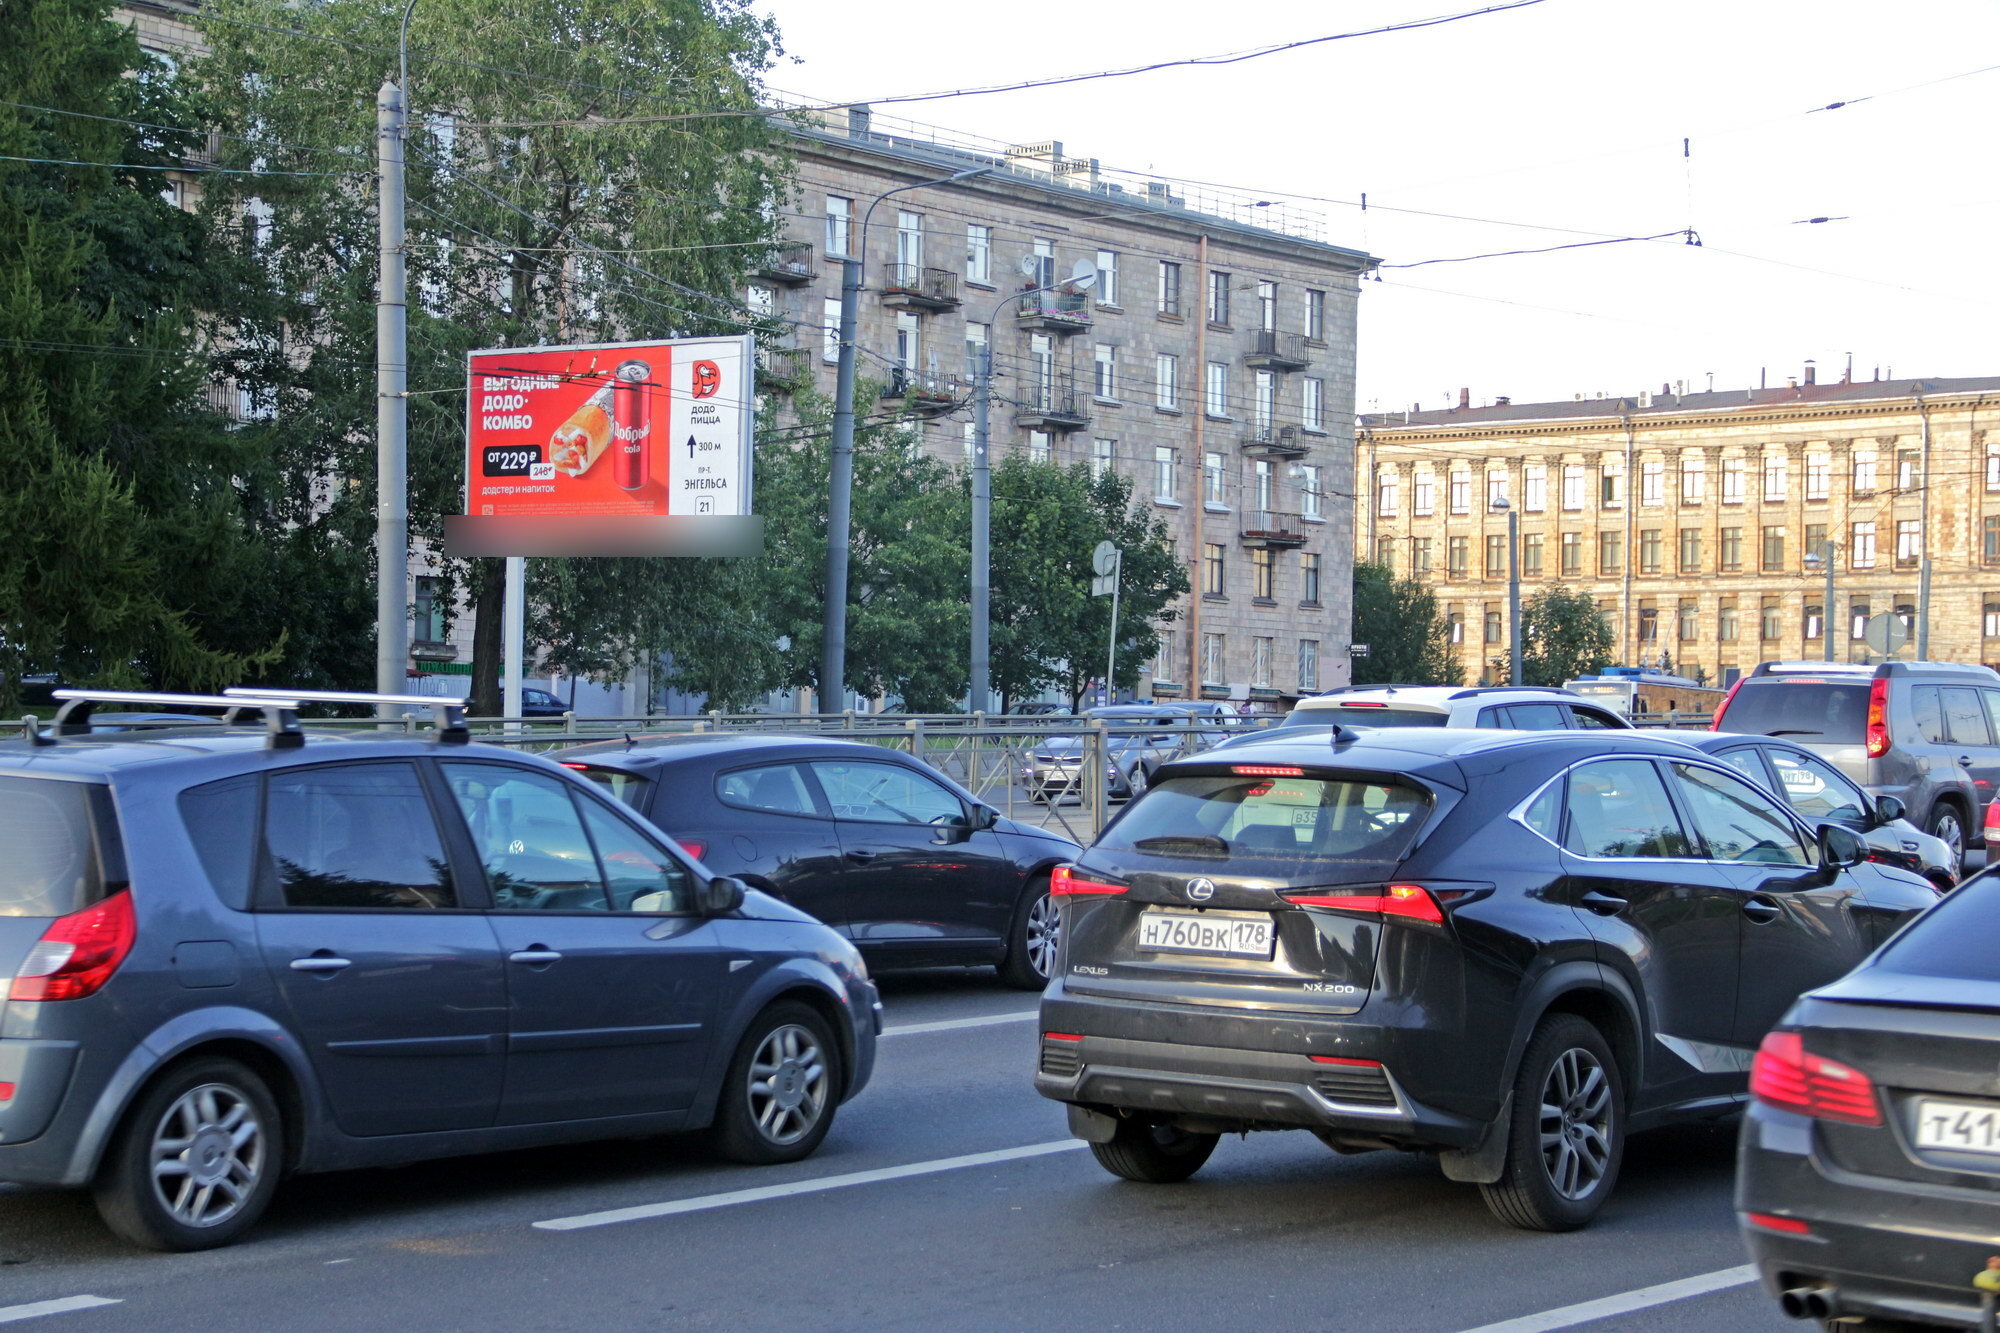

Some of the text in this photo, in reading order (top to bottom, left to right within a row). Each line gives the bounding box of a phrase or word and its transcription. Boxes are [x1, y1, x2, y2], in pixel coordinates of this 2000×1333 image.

[483, 375, 560, 392] ВЫГОДНЫЕ
[691, 405, 715, 415] ДОДО
[483, 415, 533, 430] КОМБО
[691, 416, 721, 425] ПИЦЦА
[624, 445, 641, 454] cola
[698, 442, 713, 451] 300
[685, 478, 727, 490] ЭНГЕЛЬСА
[481, 486, 514, 496] додстер
[522, 485, 555, 493] напиток
[700, 502, 710, 513] 21
[1146, 920, 1266, 949] Н760ВК 178
[1238, 942, 1256, 951] RUS
[1073, 965, 1109, 976] LEXUS
[1303, 982, 1355, 994] NX 200
[1932, 1110, 2000, 1147] Т41
